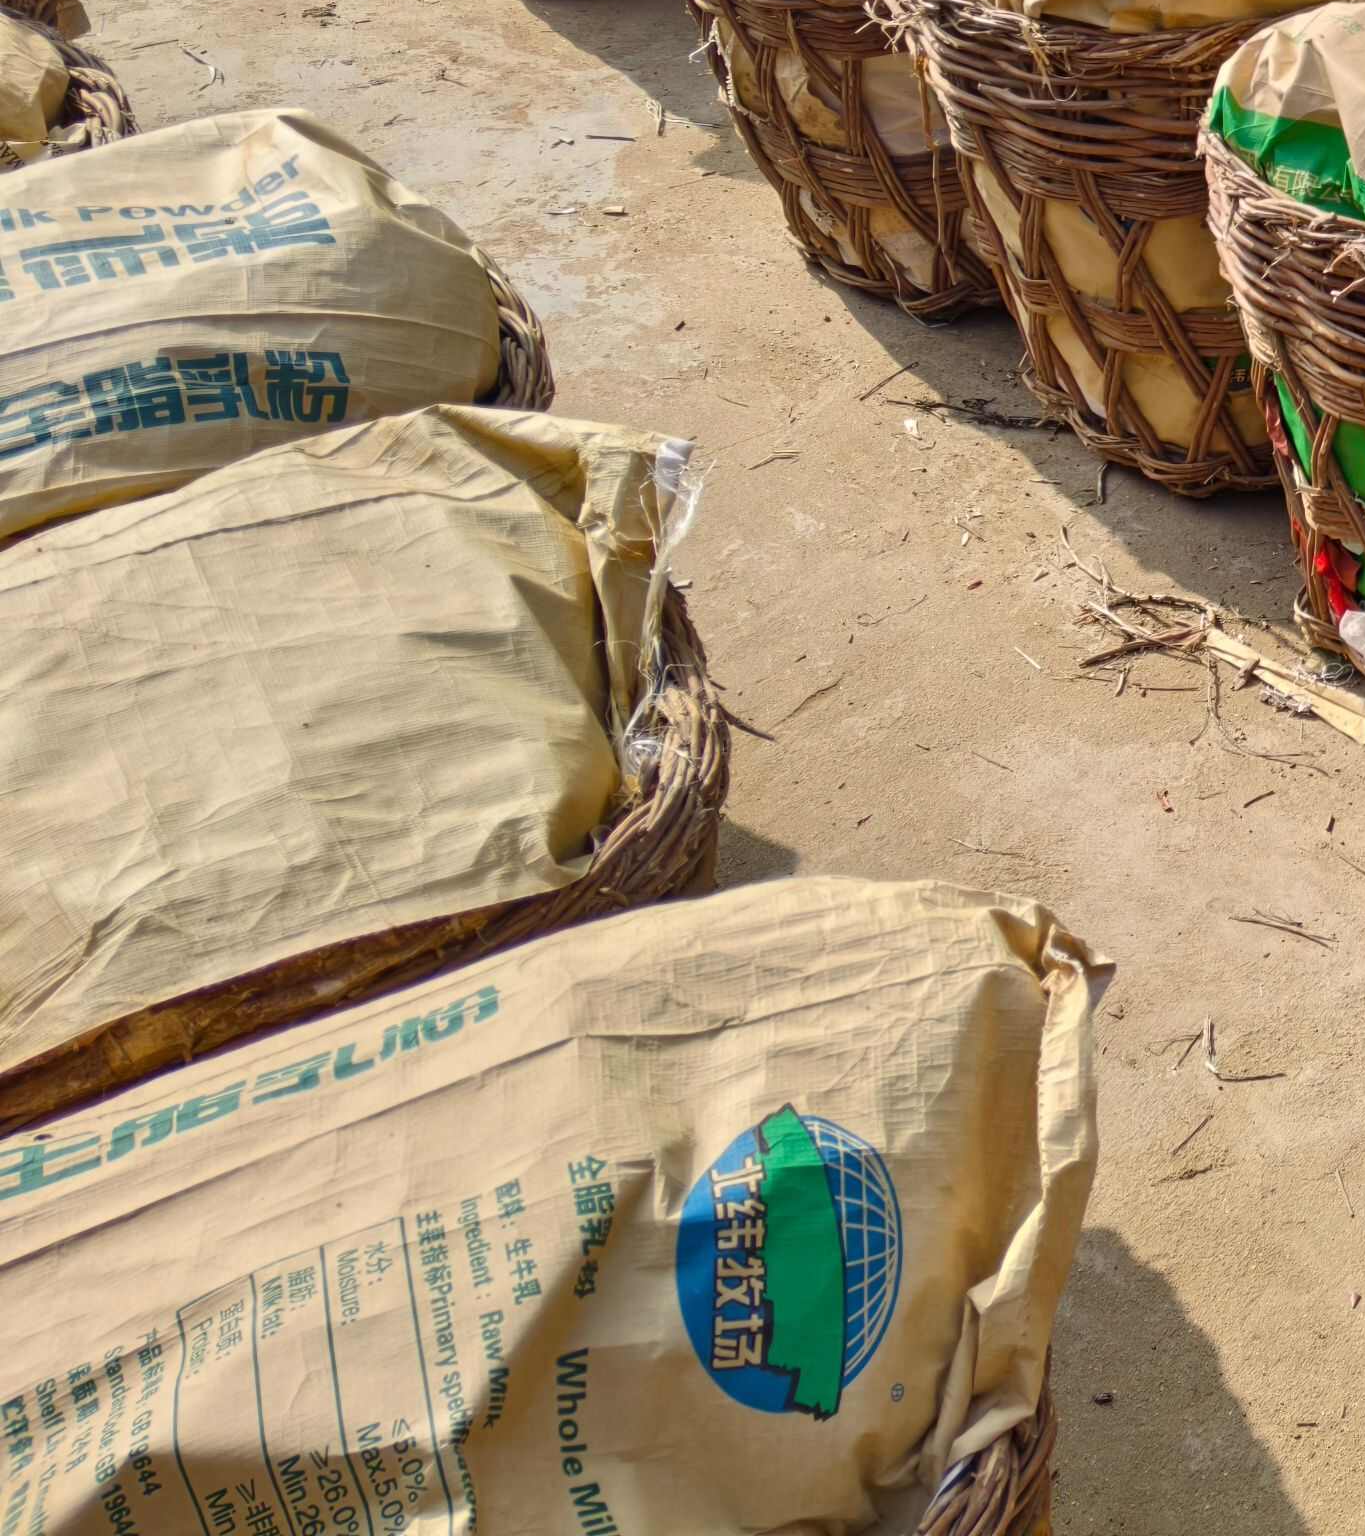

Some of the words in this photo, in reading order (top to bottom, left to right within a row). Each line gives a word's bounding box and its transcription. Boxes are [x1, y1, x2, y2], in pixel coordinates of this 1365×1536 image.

[76, 154, 299, 221] Powder
[0, 350, 350, 461] 全脂乳粉
[567, 1154, 616, 1298] 全脂乳粉
[711, 1156, 766, 1370] 北纬牧场
[480, 1310, 504, 1362] Raw
[35, 1378, 65, 1429] Shelf
[483, 1368, 509, 1429] Milk
[556, 1347, 589, 1477] Whole
[569, 1482, 622, 1536] Mil
